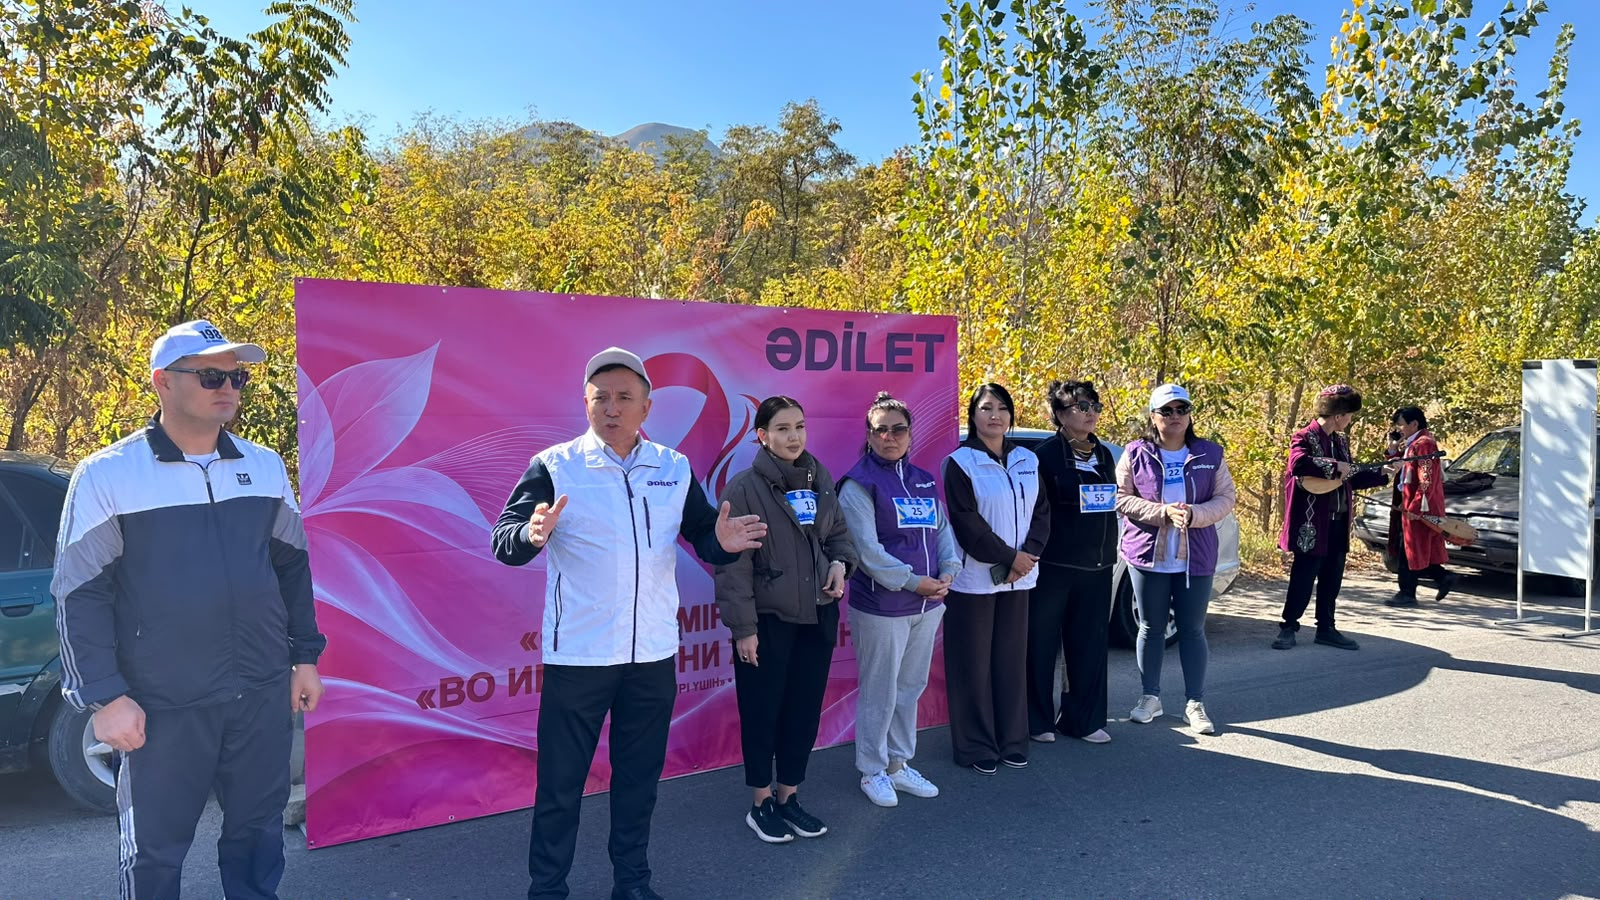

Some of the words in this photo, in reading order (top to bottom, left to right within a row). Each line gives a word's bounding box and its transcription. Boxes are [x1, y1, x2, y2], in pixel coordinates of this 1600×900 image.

[1168, 469, 1180, 477] 22
[1094, 494, 1105, 502] 55
[805, 500, 815, 511] 13
[911, 507, 923, 516] 25
[677, 602, 721, 634] МІР
[415, 671, 496, 710] «ВО
[678, 640, 720, 673] НИ
